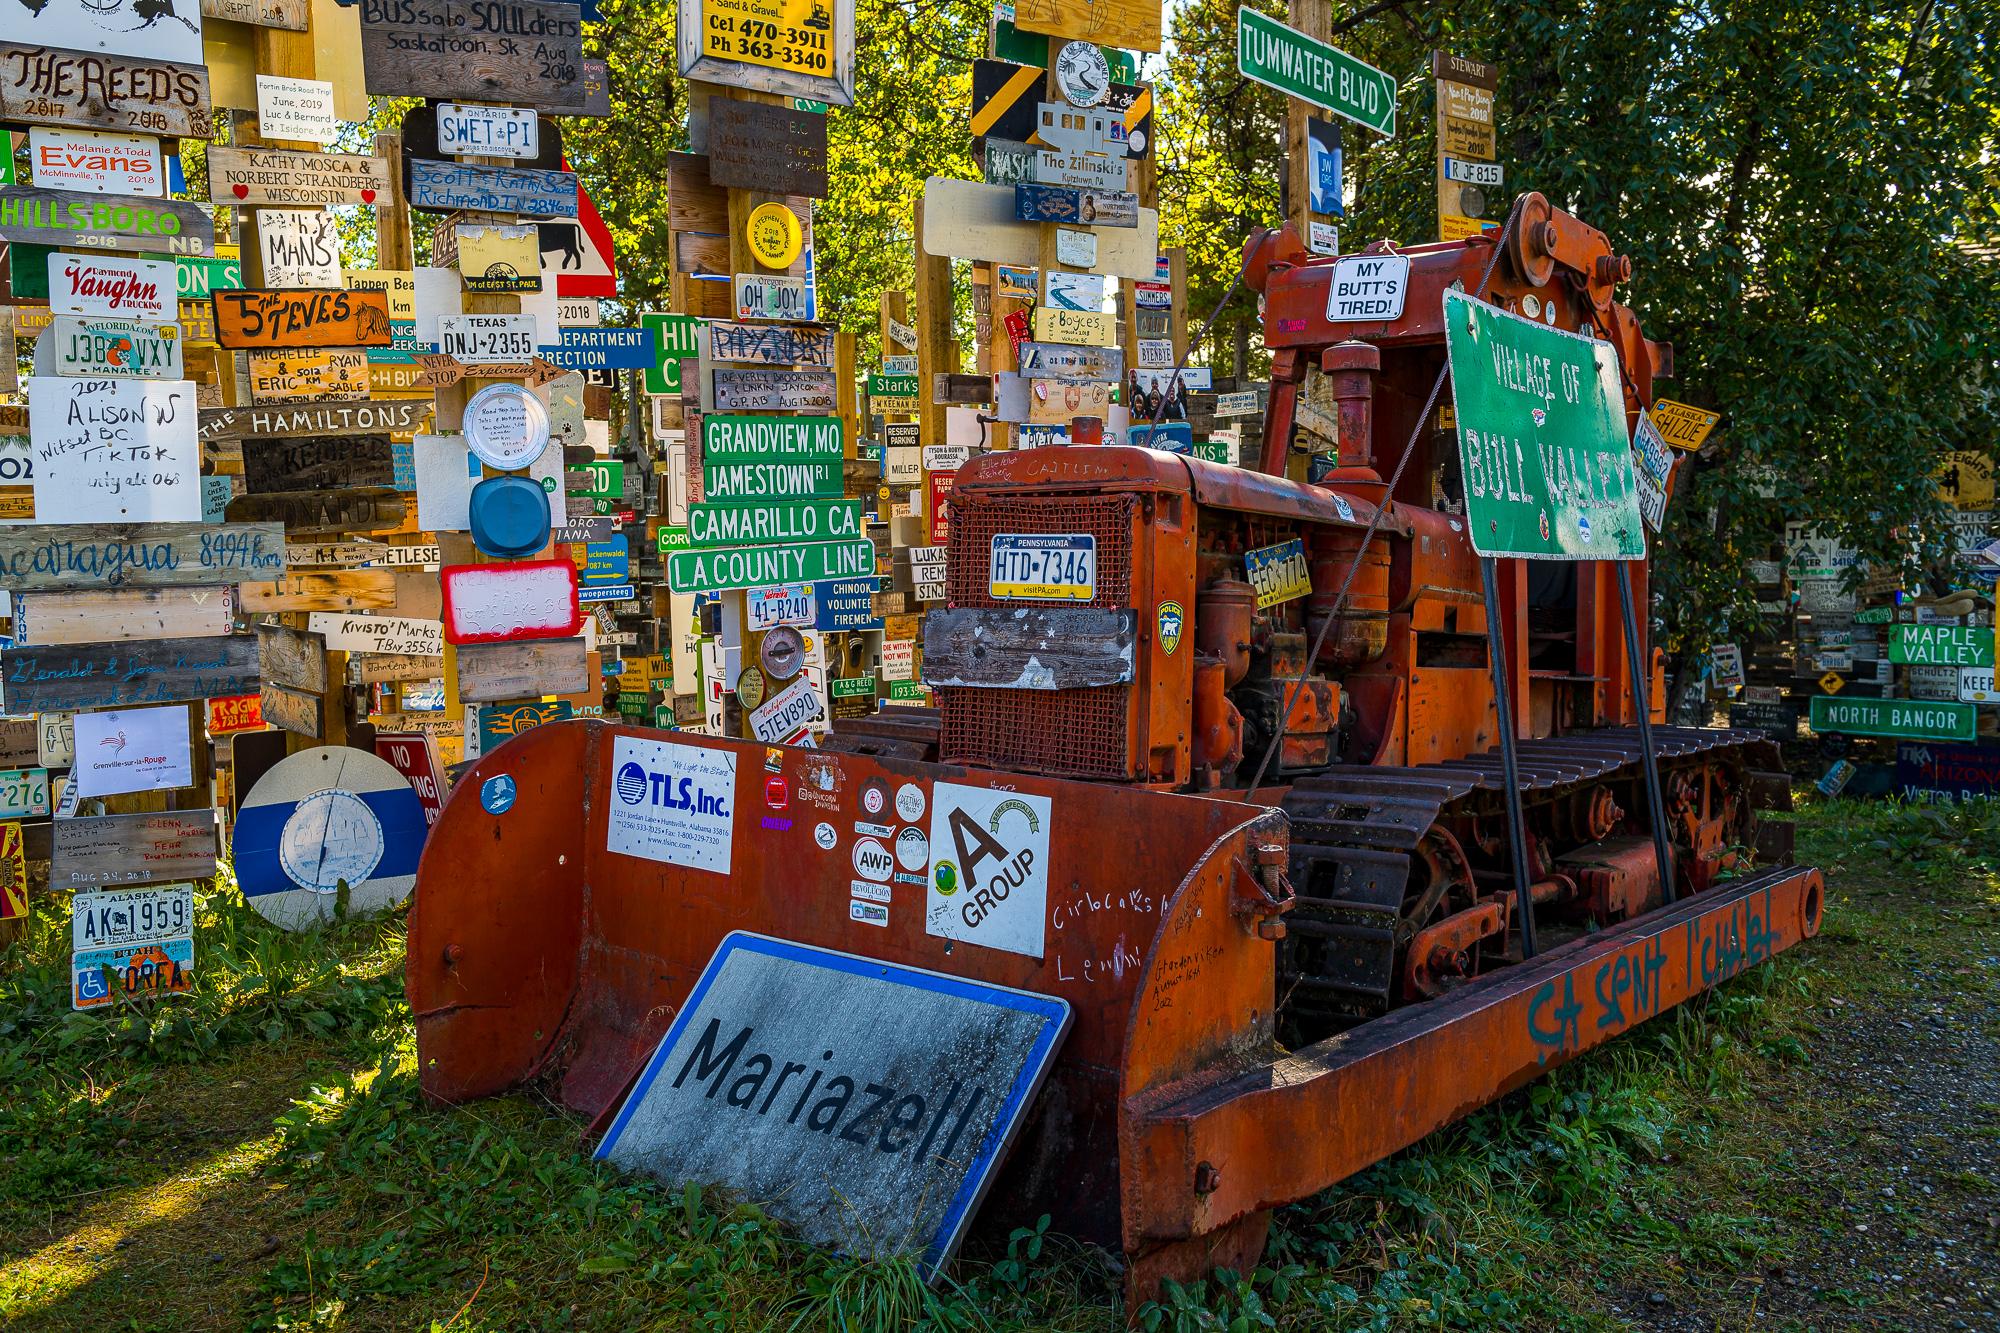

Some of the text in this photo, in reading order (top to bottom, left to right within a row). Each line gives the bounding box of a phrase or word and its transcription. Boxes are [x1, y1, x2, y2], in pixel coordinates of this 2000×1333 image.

[225, 3, 284, 22] SEPT 2018
[717, 0, 740, 10] Sand
[710, 14, 826, 50] Cel 470-3911
[387, 32, 566, 65] Saskatoon, Aug
[711, 35, 826, 70] Ph 363-3340
[7, 47, 74, 99] THE
[539, 61, 576, 81] 2018
[1242, 23, 1378, 115] TUMWATER BLVD
[1450, 56, 1487, 78] STEWART
[259, 82, 314, 94] Fortin Bros Road
[272, 96, 322, 110] June, 2019
[24, 99, 65, 118] 2017
[128, 111, 167, 131] 2018
[265, 109, 331, 123] Luc Bernard
[467, 109, 507, 119] ONTARIO
[1469, 108, 1488, 121] 2018
[263, 123, 333, 136] St. Isidore, AB
[443, 117, 530, 147] SWET PI
[67, 143, 151, 157] Melanie Todd
[1467, 141, 1485, 155] 2018
[40, 145, 153, 173] Evans
[250, 153, 352, 173] KATHY MOSCA
[1042, 153, 1123, 176] The Zilinski's
[39, 169, 155, 184] McMinnville, Tn 2018
[225, 170, 381, 190] NORBERT STRANDBERG
[1452, 163, 1498, 182] R JF 815
[264, 188, 345, 203] WISCONSIN
[0, 198, 181, 235] HILLSBORO
[1443, 225, 1461, 235] Dillon
[75, 234, 204, 255] 2018 NB
[269, 233, 332, 267] MANS
[92, 266, 132, 279] Raymond
[1357, 262, 1384, 276] MY
[64, 266, 157, 309] Vaughn
[519, 280, 537, 288] PAUL
[1338, 280, 1397, 297] BUTT'S
[122, 300, 162, 310] TRUCKING
[258, 292, 281, 313] THE
[744, 284, 799, 310] OH JOY
[1139, 290, 1168, 304] SUMMERS
[393, 299, 411, 312] km
[564, 305, 590, 319] 2018
[1338, 299, 1392, 315] TIRED!
[469, 318, 507, 328] TEXAS
[65, 334, 174, 367] J38 VXY
[444, 332, 531, 355] DNJ 2355
[329, 354, 361, 367] RYAN
[423, 354, 537, 378] NEVER Exploring
[92, 366, 150, 376] MANATEE
[297, 367, 321, 376] 5012
[427, 371, 457, 384] STOP
[1490, 340, 1580, 411] VILLAGE OF
[259, 377, 298, 390] ERIC
[328, 382, 363, 393] SABLE
[743, 383, 775, 392] LINKIN
[256, 395, 309, 405] BURLINGTON
[752, 396, 797, 407] AB AUG
[198, 405, 413, 439] THE HAMILTONS
[1667, 407, 1702, 421] ALASKA
[887, 427, 919, 436] RESERVED
[1656, 414, 1706, 442] SHIZUE
[708, 422, 842, 458] GRANDVIEW, MO.
[890, 436, 916, 445] PARKING
[892, 464, 918, 474] MILLER
[1465, 428, 1629, 509] BULL VALLEY
[706, 464, 815, 497] JAMESTOWN
[691, 505, 860, 541] CAMARILLO CA.
[1017, 539, 1069, 548] PENNSYLVANIA
[673, 544, 870, 588] L.A. COUNTY LINE
[995, 551, 1087, 585] HTD 7346
[832, 583, 871, 594] CHINOOK
[1023, 586, 1061, 595] visitPA.com
[16, 593, 28, 643] YUKON
[754, 598, 808, 622] 41-B240
[1160, 605, 1181, 617] POLICE
[834, 614, 872, 625] FIREMEN
[396, 620, 435, 639] Marks
[1903, 627, 1977, 647] MAPLE
[404, 640, 433, 654] 3556
[1903, 646, 1984, 665] VALLEY
[1912, 667, 1956, 677] SCHULTZ
[856, 678, 872, 687] REED
[1963, 675, 1994, 691] KEEP
[758, 693, 815, 743] 5TEV890
[1828, 705, 1957, 730] NORTH BANGOR
[391, 745, 410, 769] NO
[648, 771, 696, 817] TLS,
[697, 787, 730, 818] Inc.
[147, 819, 182, 830] GLENN
[613, 809, 627, 818] 1221
[626, 810, 644, 822] Jordan
[689, 823, 712, 834] Alabama
[712, 827, 730, 837] 35816
[621, 821, 636, 831] (256)
[61, 830, 98, 840] SMITH
[154, 841, 182, 851] FEHR
[947, 806, 1009, 893] A
[859, 851, 892, 871] AWP
[72, 872, 97, 883] AUG
[961, 848, 1035, 929] GROUP
[109, 891, 159, 903] ALASKA
[85, 899, 183, 939] AK 1959
[114, 948, 154, 960] UTAH
[671, 1017, 985, 1168] Mariazell
